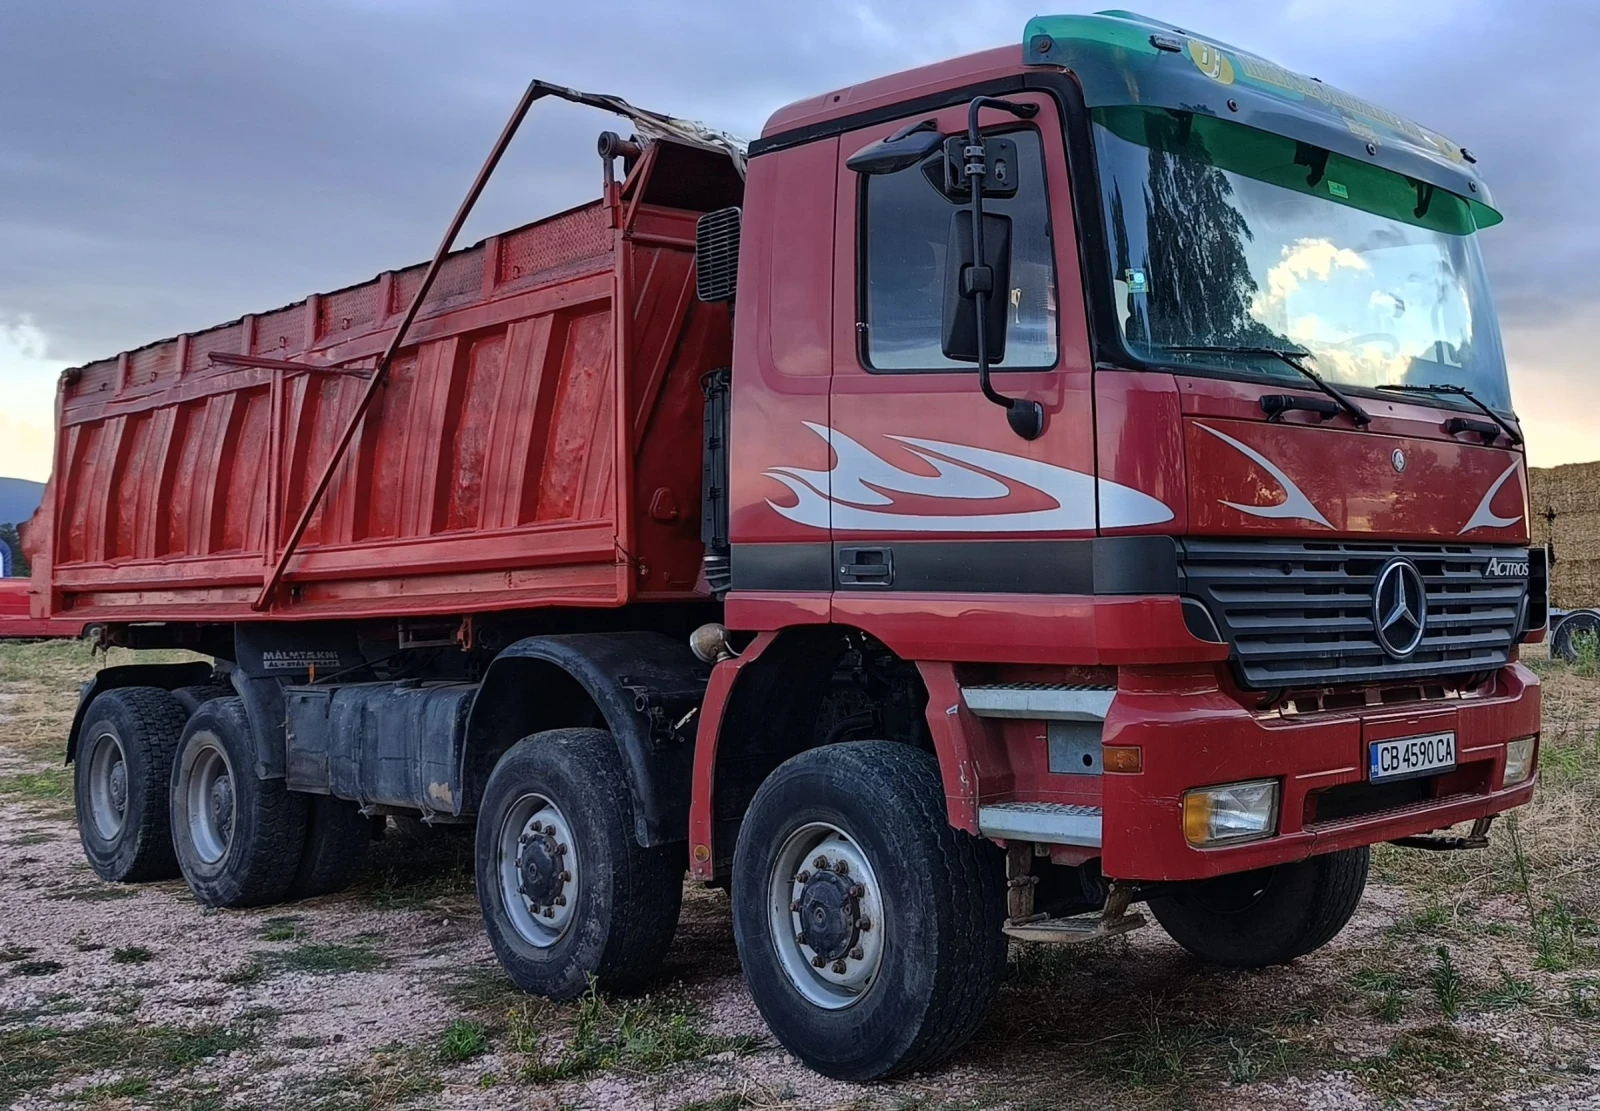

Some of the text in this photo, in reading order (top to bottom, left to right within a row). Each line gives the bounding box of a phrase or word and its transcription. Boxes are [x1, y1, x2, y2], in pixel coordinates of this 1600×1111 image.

[1381, 738, 1453, 772] CB 4590 CA
